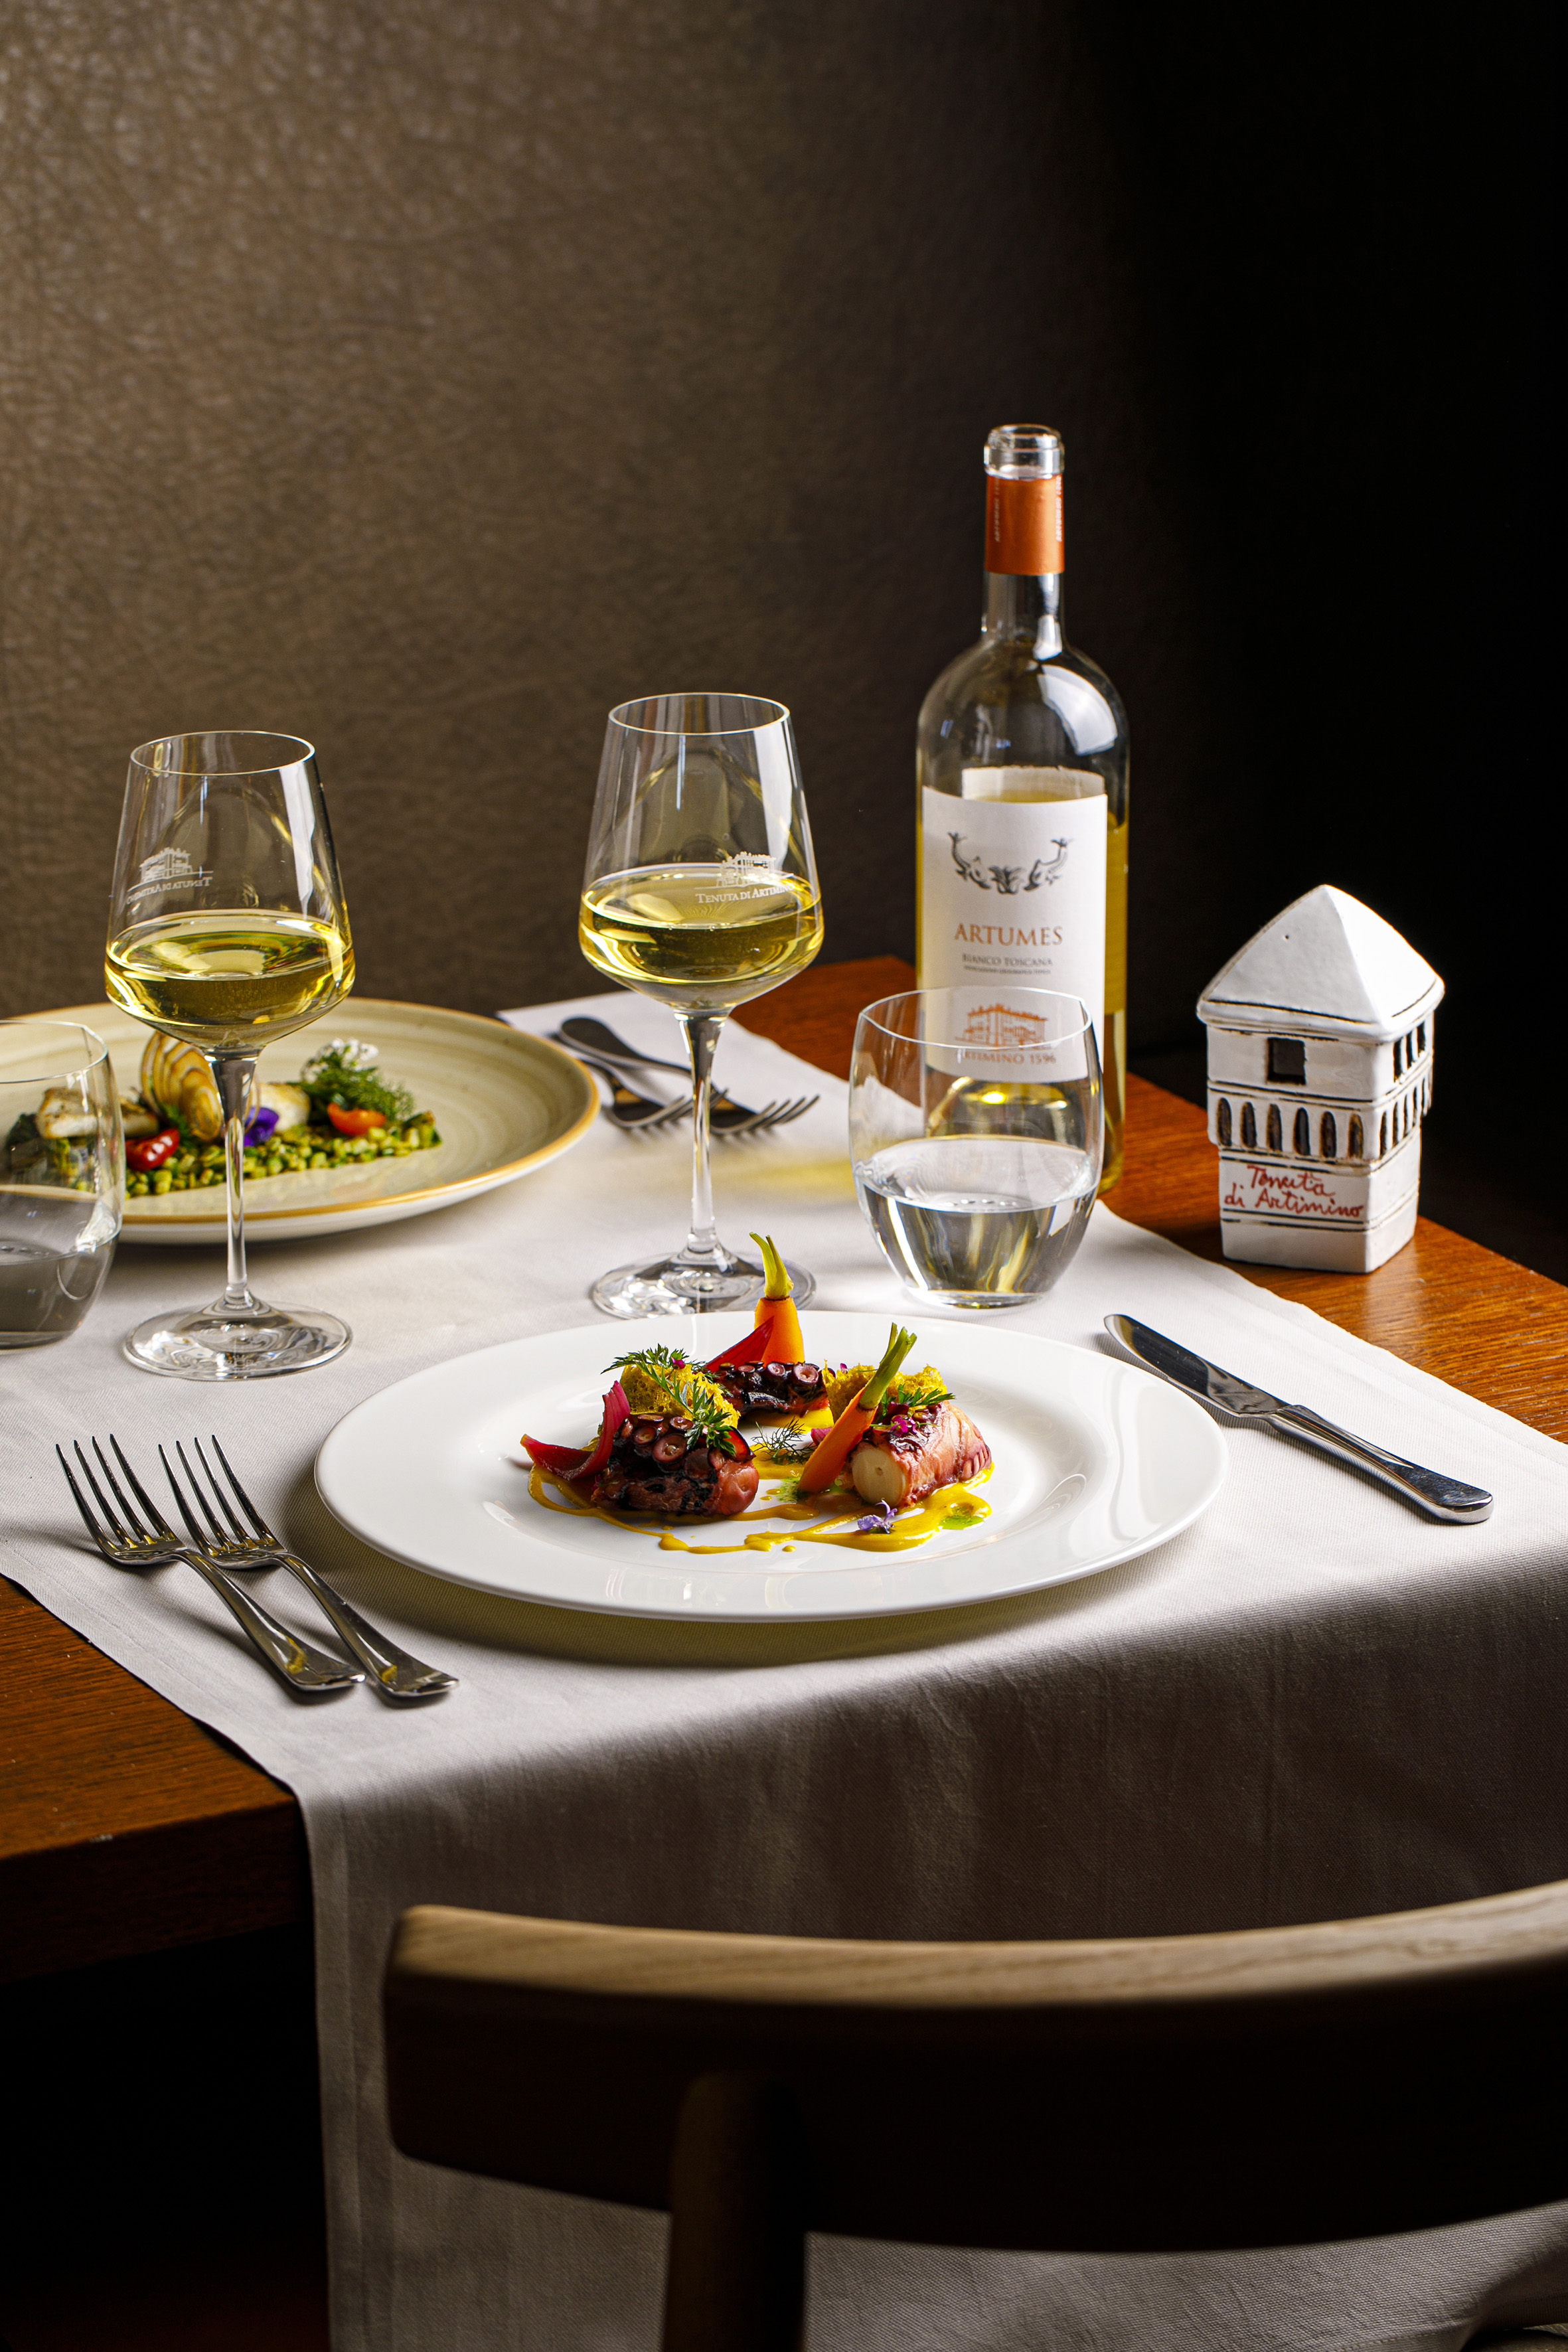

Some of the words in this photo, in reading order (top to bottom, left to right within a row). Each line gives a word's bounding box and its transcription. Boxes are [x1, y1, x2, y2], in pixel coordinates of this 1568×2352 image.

[695, 894, 739, 903] TENUTA
[954, 922, 1063, 947] ARTUMES
[963, 953, 1002, 966] BIANCO
[1004, 956, 1053, 967] TOSCANA
[1030, 1052, 1057, 1065] 1596
[1247, 1164, 1336, 1198] Tenuta
[1223, 1182, 1245, 1208] di
[1255, 1188, 1365, 1217] Artimino
